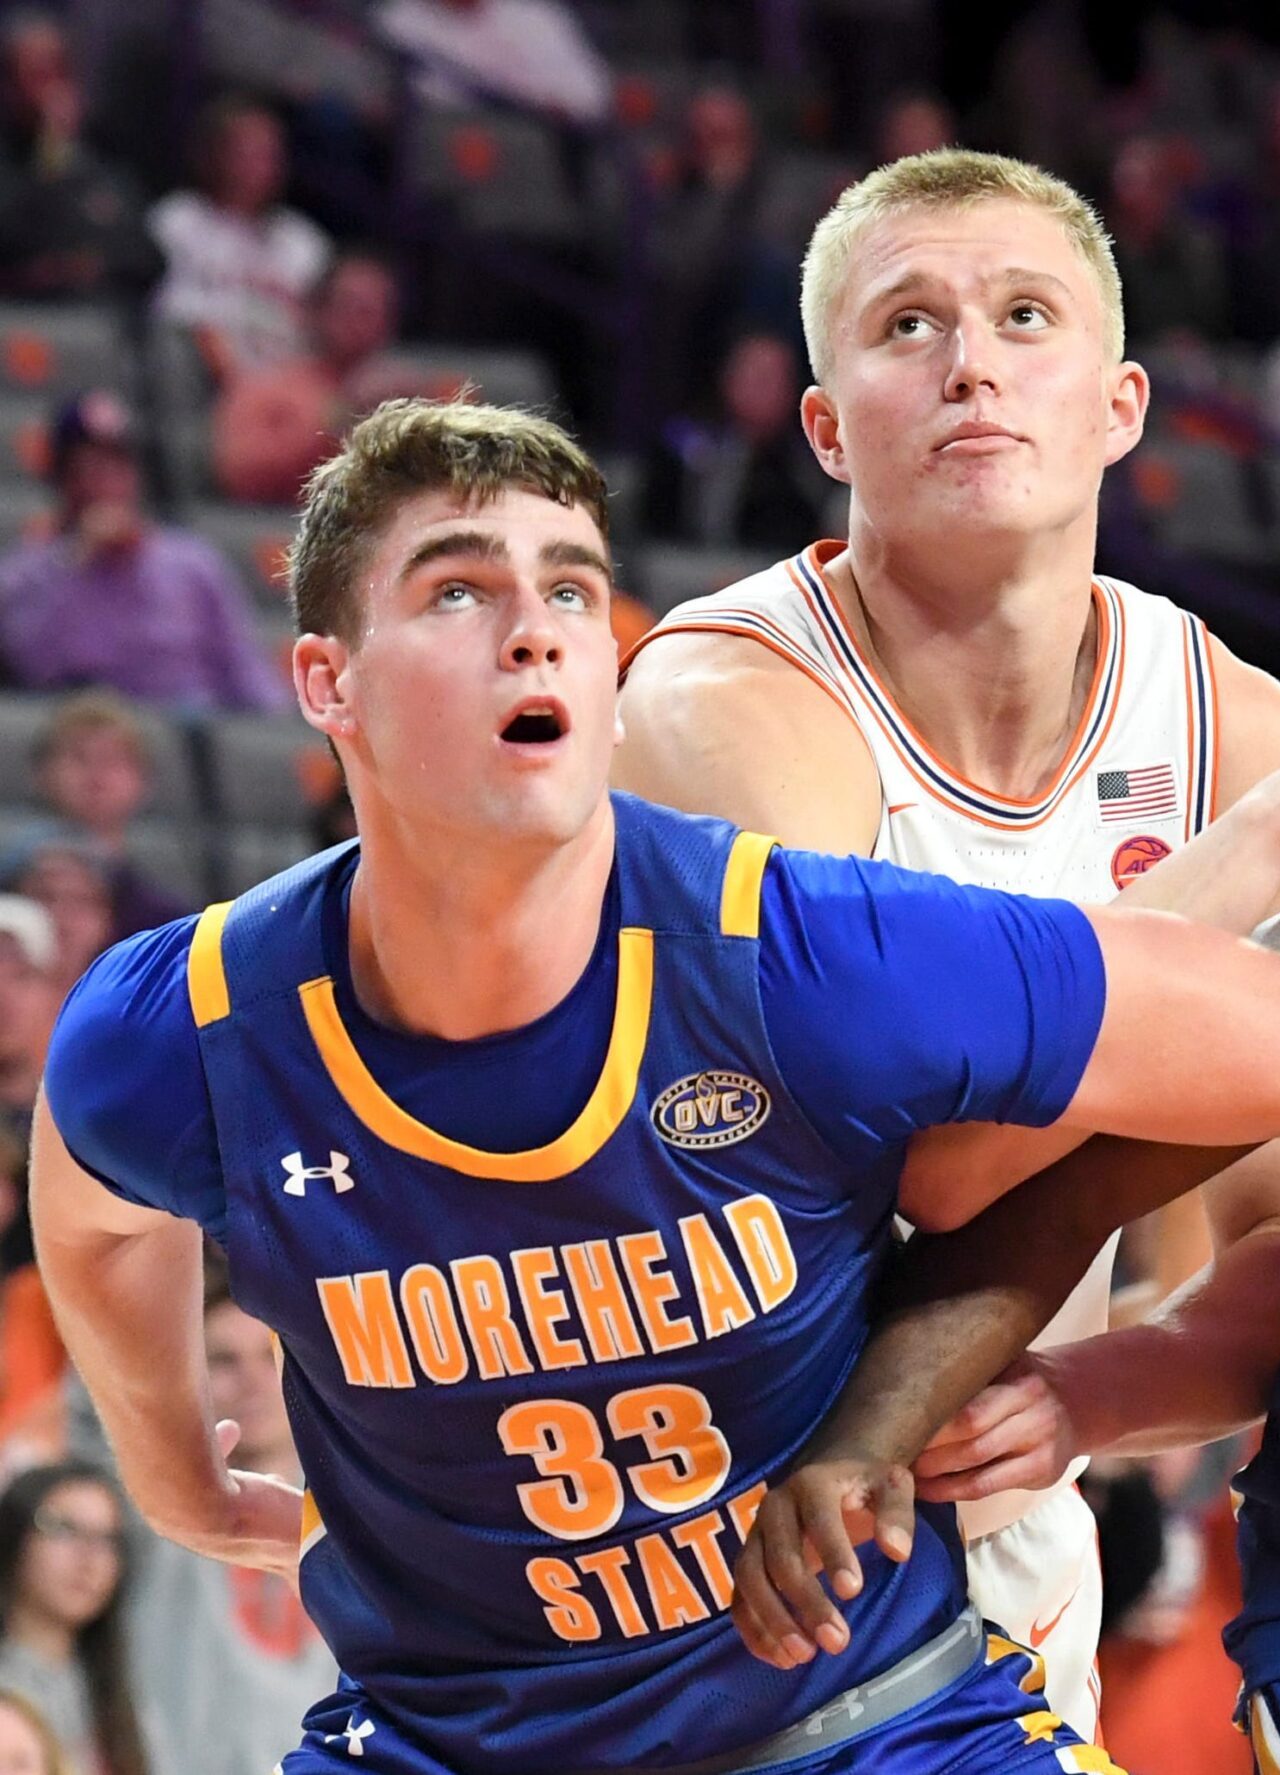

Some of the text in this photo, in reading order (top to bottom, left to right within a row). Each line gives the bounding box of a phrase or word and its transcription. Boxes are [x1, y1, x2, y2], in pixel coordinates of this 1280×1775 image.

[674, 1090, 744, 1131] OVC
[316, 1194, 798, 1388] MOREHEAD
[497, 1384, 731, 1540] 33
